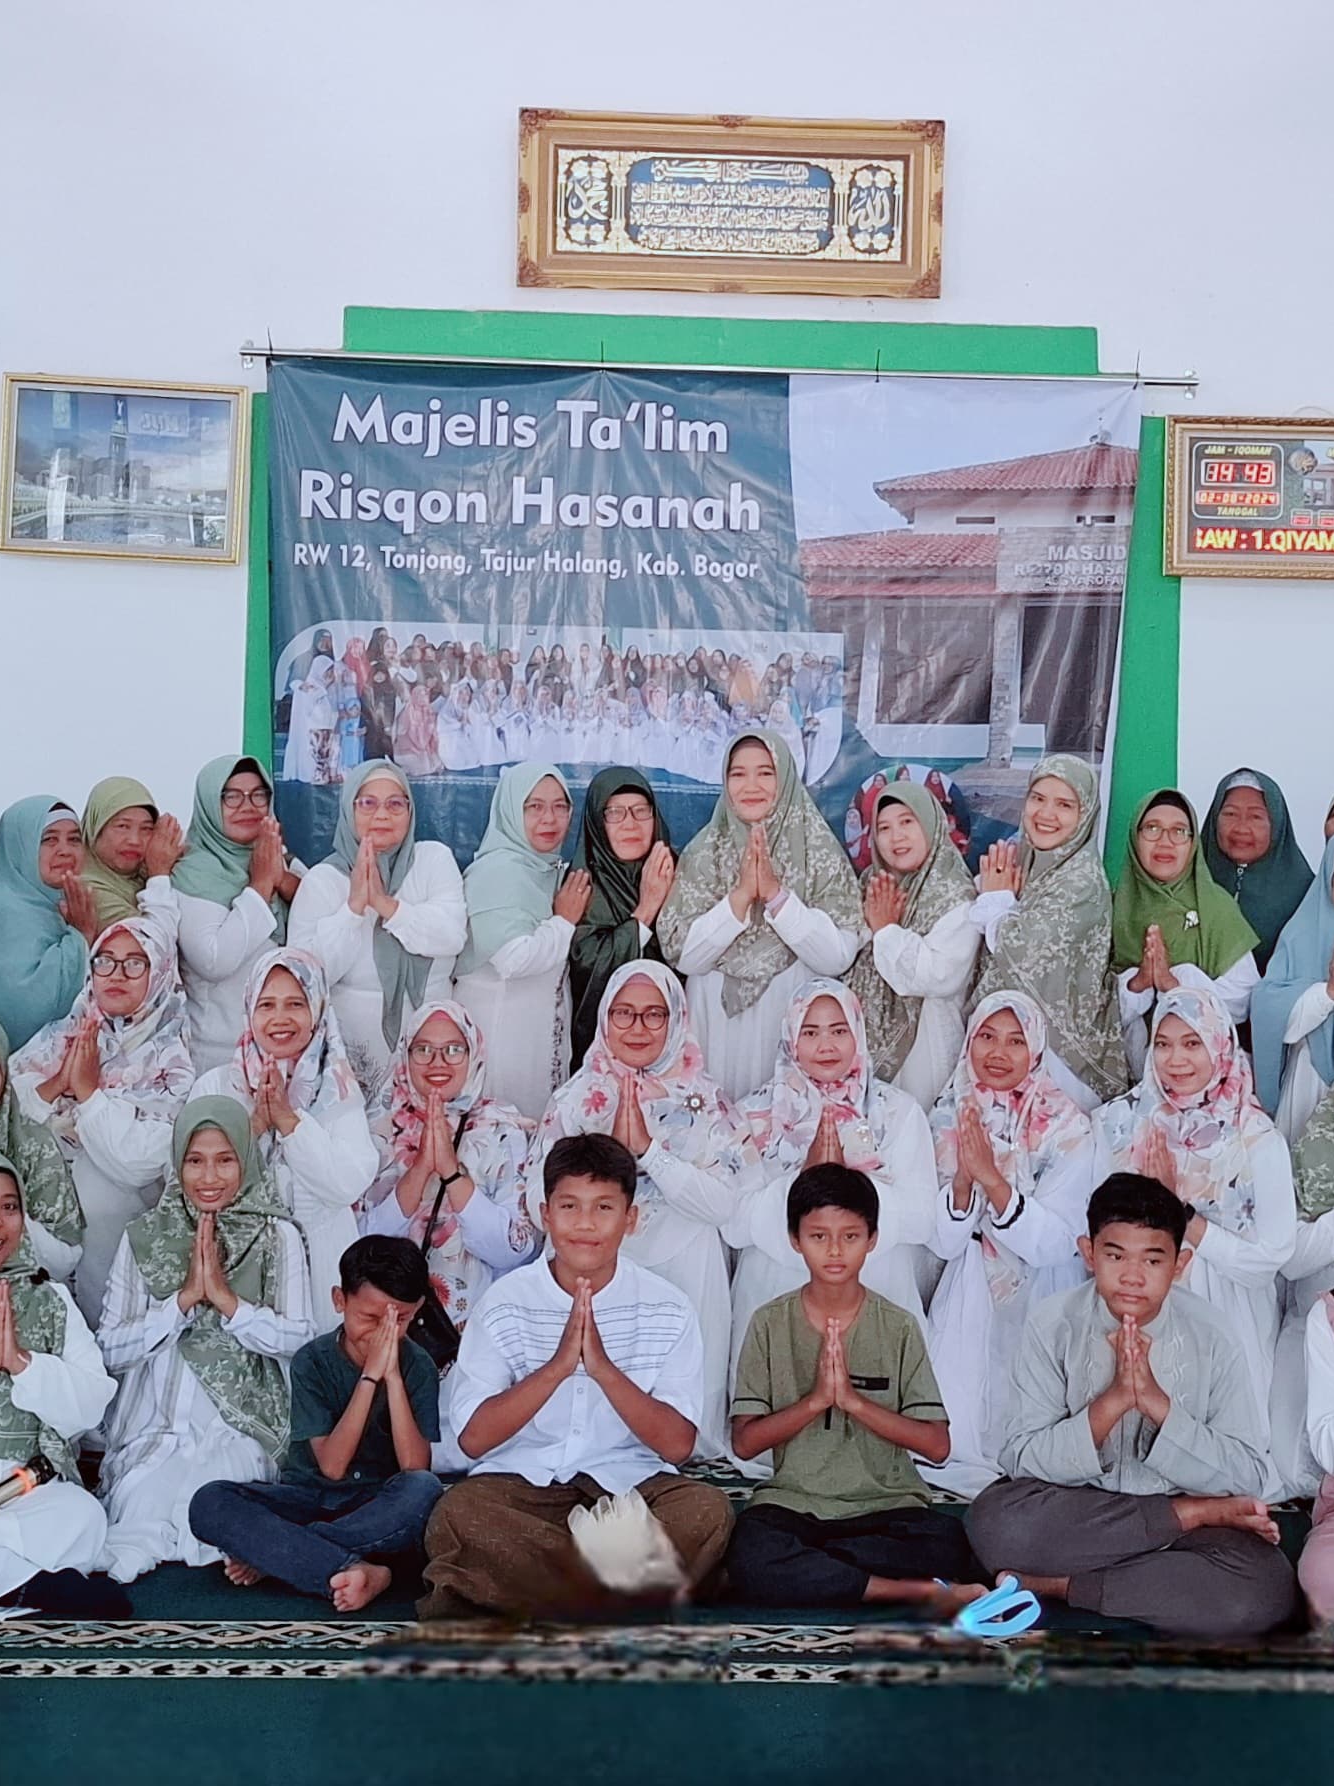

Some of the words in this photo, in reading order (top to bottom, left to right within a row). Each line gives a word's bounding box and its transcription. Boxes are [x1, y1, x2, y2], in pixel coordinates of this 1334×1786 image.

[332, 391, 538, 457] Majelis
[300, 469, 487, 534] Risqon
[511, 476, 761, 531] Hasanah
[293, 543, 331, 566] RW
[339, 545, 372, 571] 12,
[379, 545, 472, 576] Tonjong,
[480, 548, 535, 576] Tajur
[542, 550, 628, 579] Halang,
[636, 552, 687, 577] Kab.
[694, 557, 759, 583] Bogor
[1048, 544, 1127, 561] MASJID
